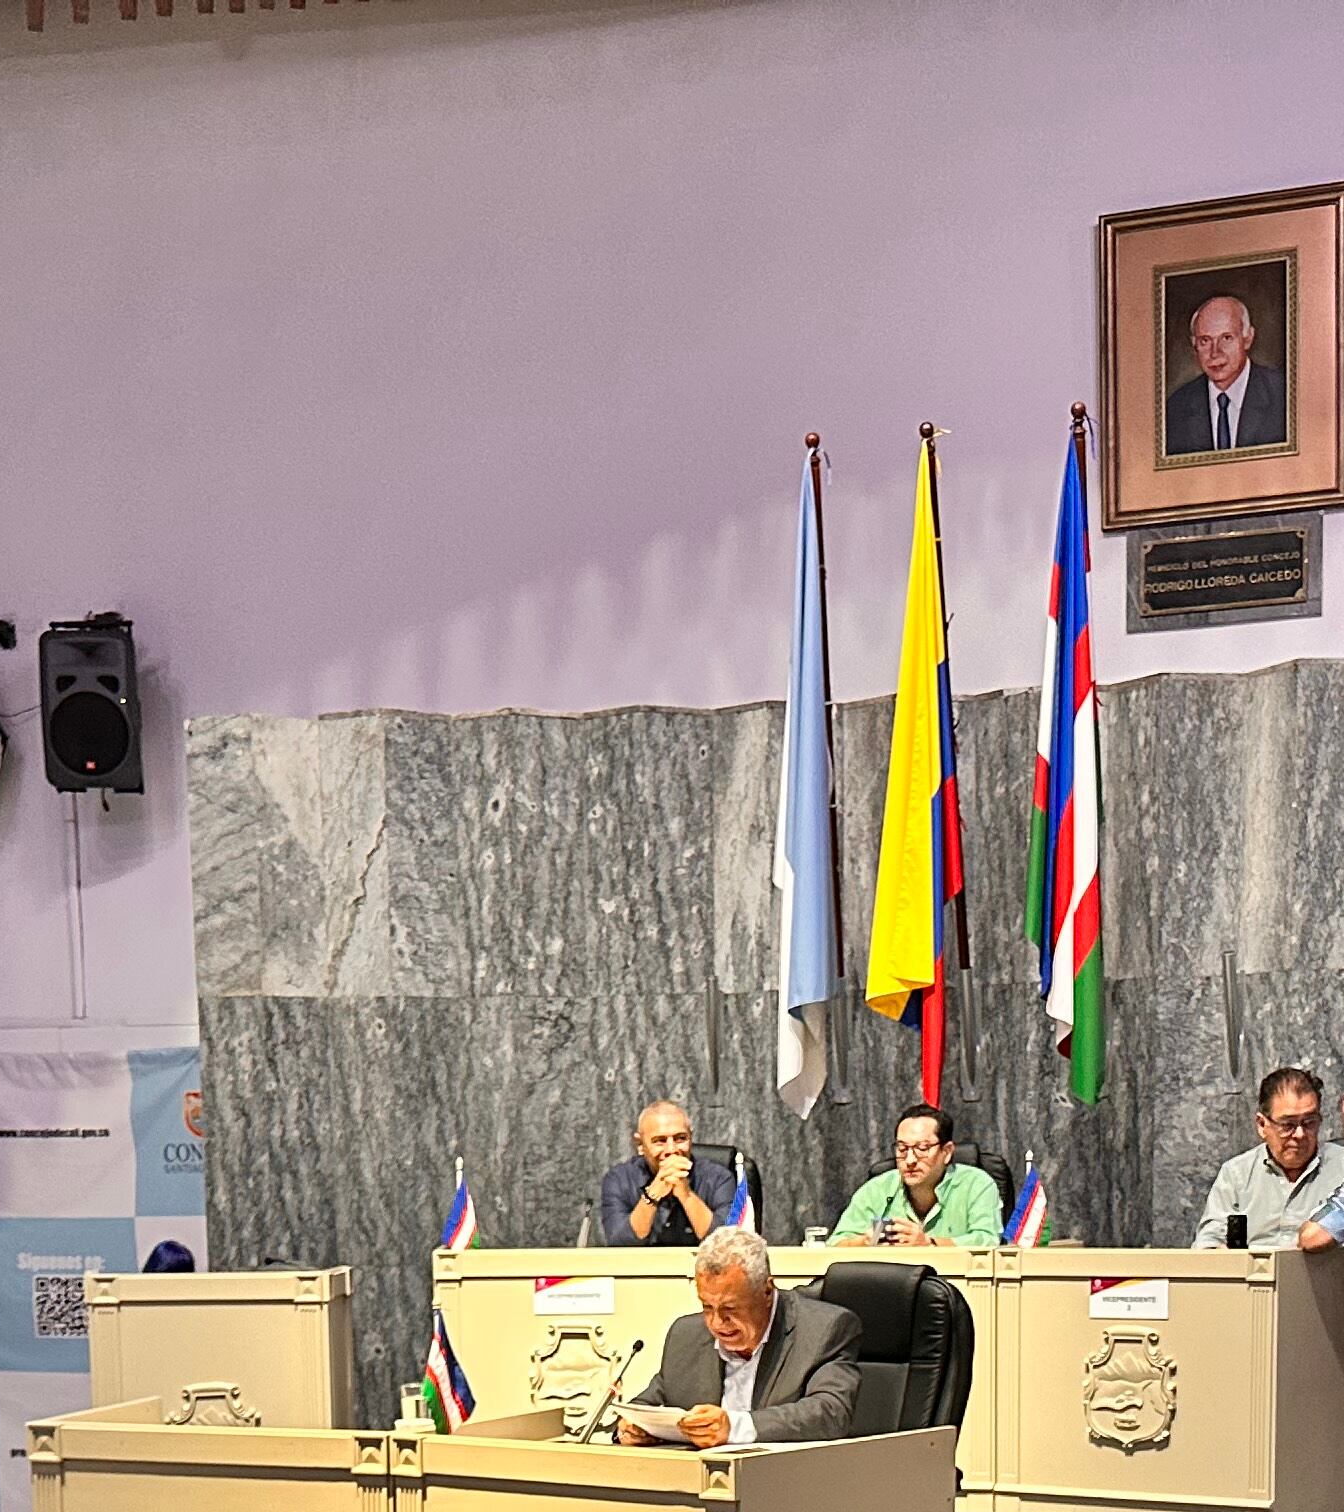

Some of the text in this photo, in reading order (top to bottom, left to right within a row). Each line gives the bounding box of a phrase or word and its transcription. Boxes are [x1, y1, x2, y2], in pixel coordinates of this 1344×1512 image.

[1192, 561, 1208, 570] DEL
[1210, 555, 1259, 567] HONORABLE
[1261, 551, 1301, 562] CONCEJO
[1145, 568, 1301, 594] RODRIGO LLOREDA CAICEDO
